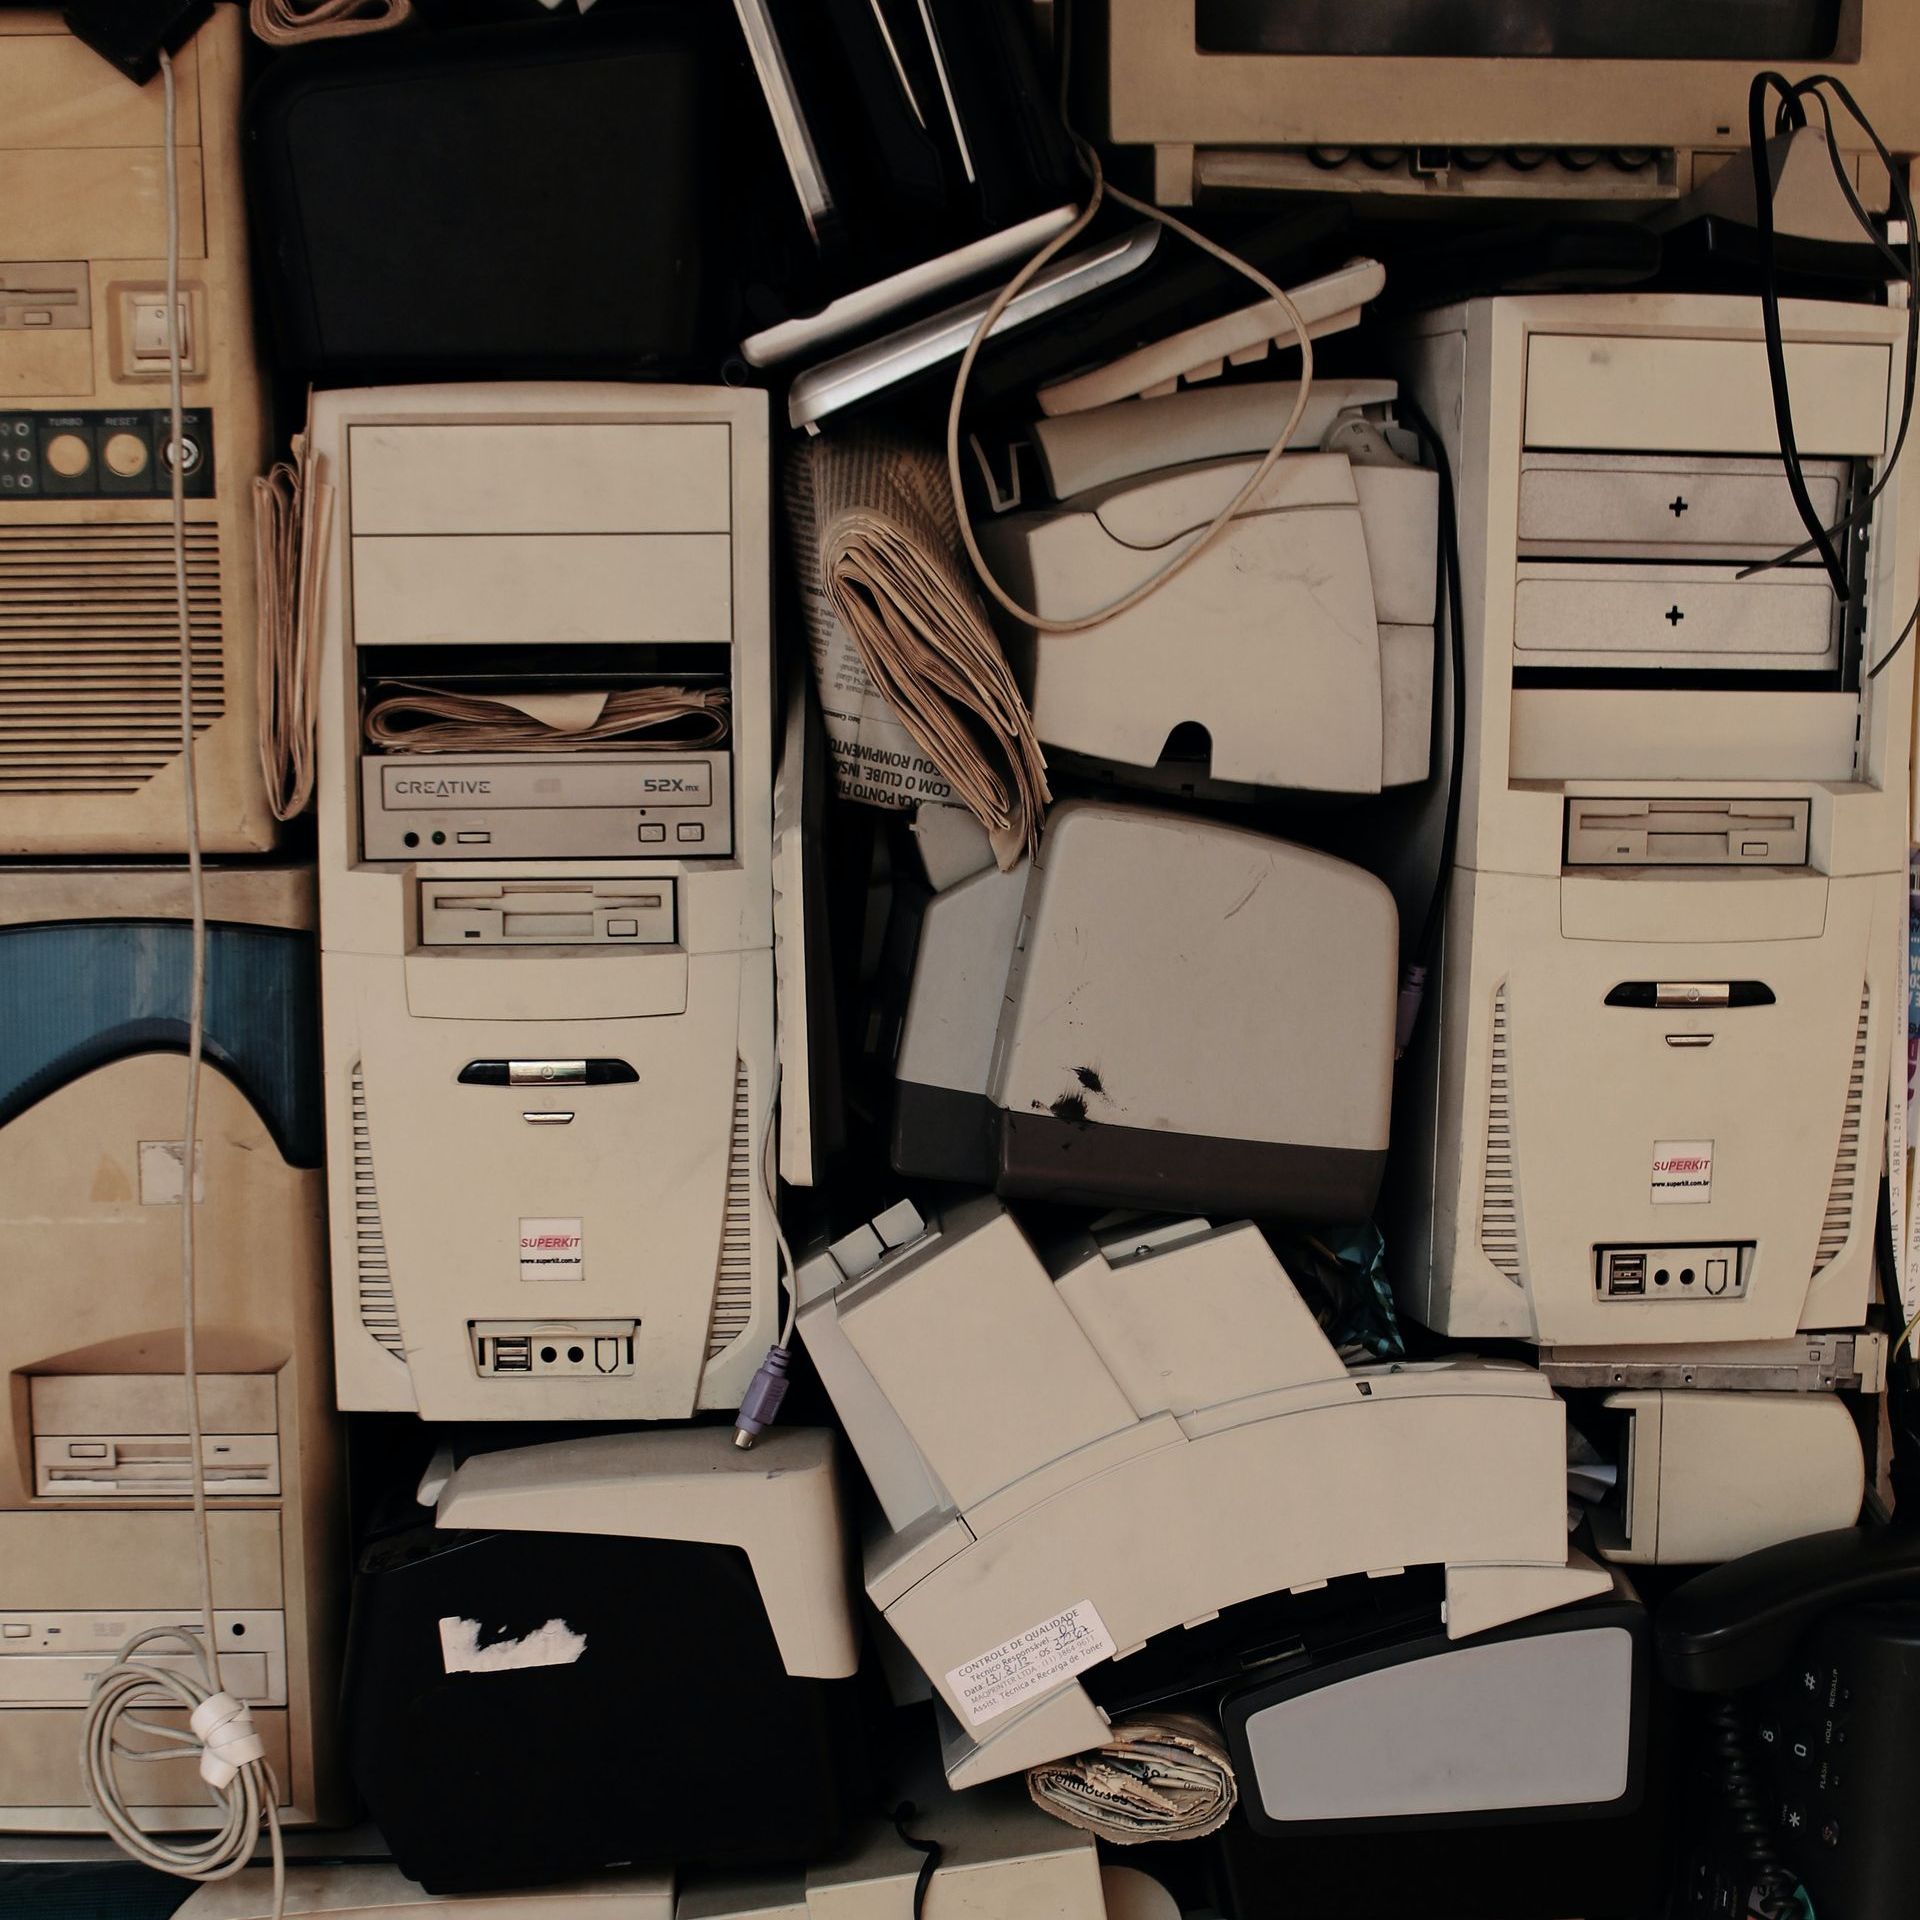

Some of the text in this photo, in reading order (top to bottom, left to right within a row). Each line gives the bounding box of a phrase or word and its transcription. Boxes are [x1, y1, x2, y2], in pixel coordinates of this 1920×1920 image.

[49, 417, 84, 427] TURBO
[105, 416, 138, 427] RESET
[863, 766, 903, 787] CLUBE.
[905, 776, 917, 790] O
[394, 780, 491, 798] CREATIVE
[854, 784, 895, 806] PONTO
[918, 780, 951, 798] COM
[1894, 1103, 1902, 1131] 2014
[1892, 1136, 1901, 1175] ABRIL
[1653, 1160, 1711, 1171] SUPERKIT
[520, 1237, 581, 1248] SUPERKIT
[958, 1608, 1080, 1677] CONTROLE DE QUALIDADE
[1036, 1661, 1069, 1681] Recarga
[1069, 1654, 1080, 1664] de
[1079, 1641, 1104, 1657] Toner
[1762, 1729, 1774, 1743] 8
[1825, 1720, 1833, 1745] HOLD
[1819, 1761, 1829, 1790] FLASH
